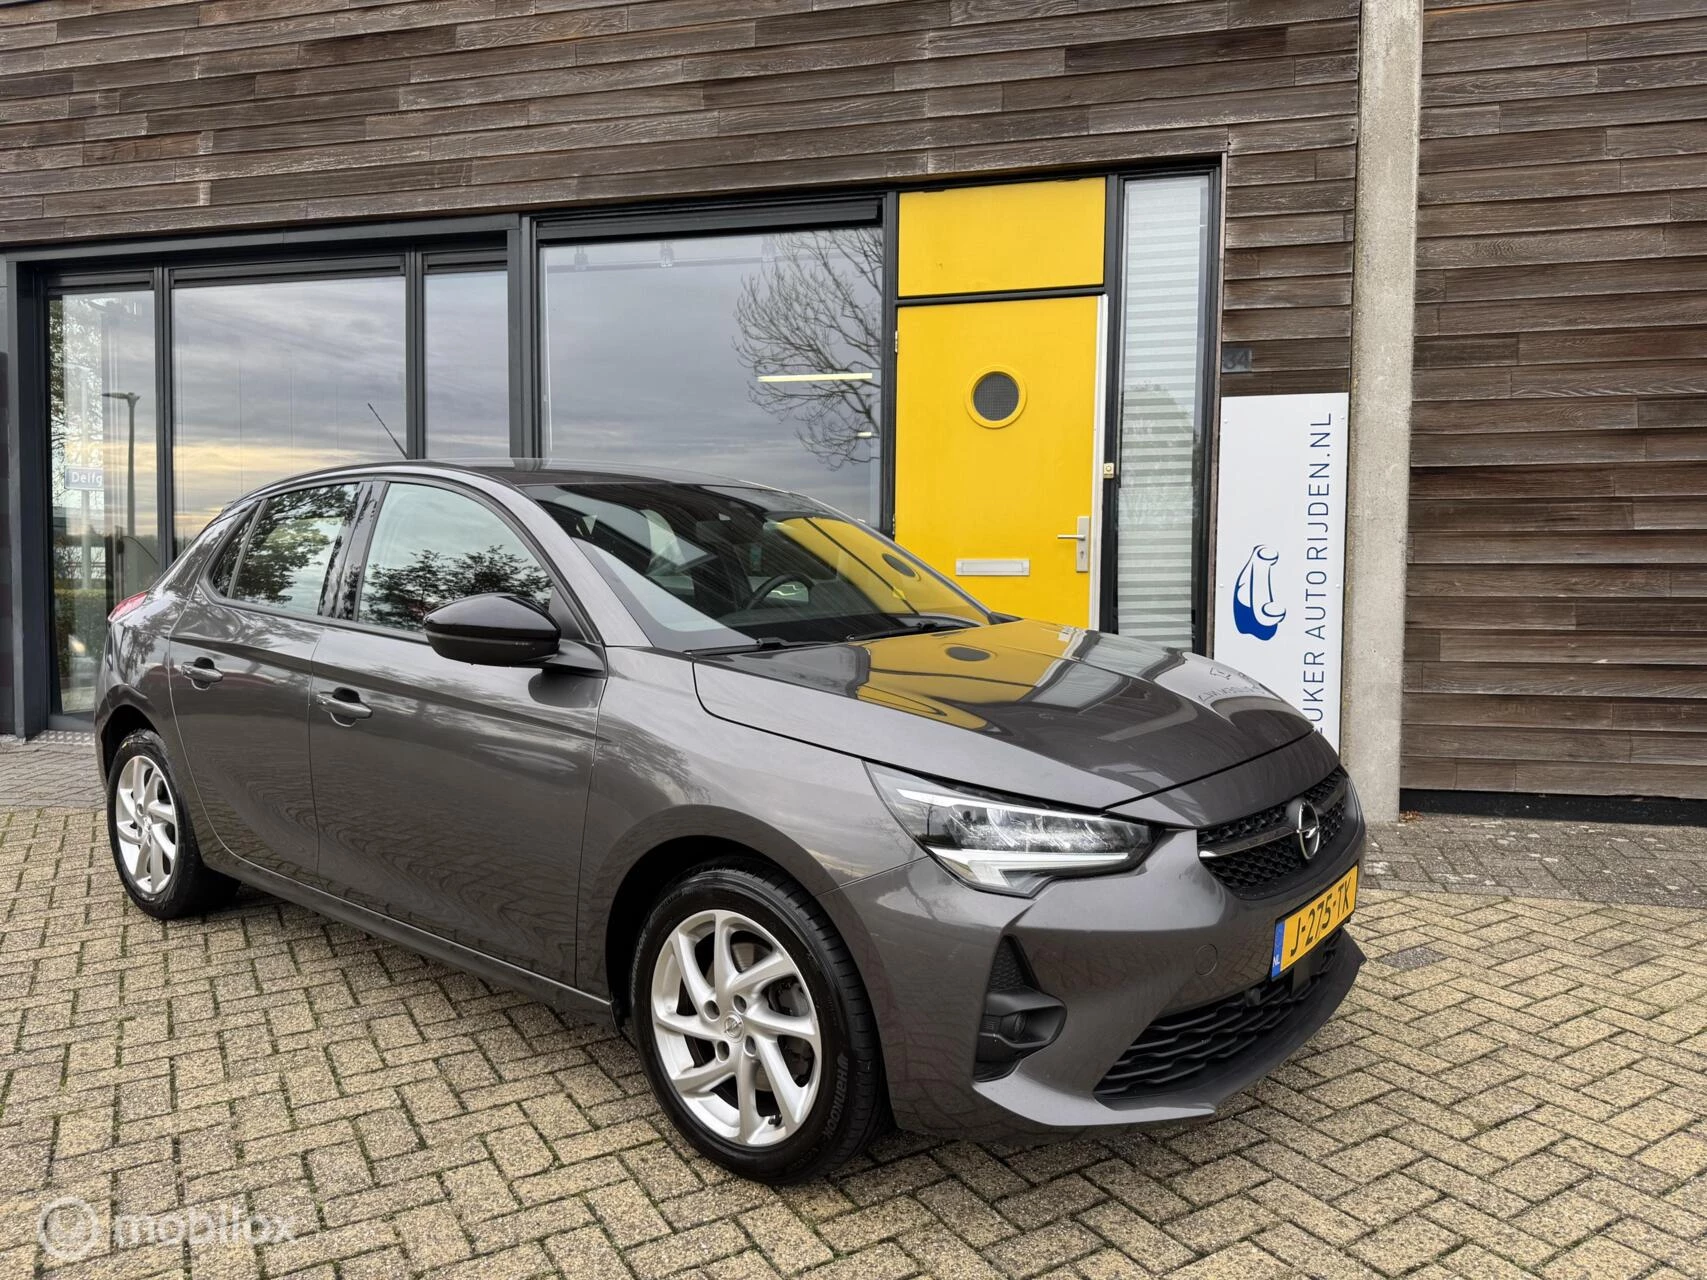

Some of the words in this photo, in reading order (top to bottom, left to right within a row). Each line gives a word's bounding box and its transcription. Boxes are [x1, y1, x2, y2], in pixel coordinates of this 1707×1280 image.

[1306, 413, 1331, 561] RIJDEN.NL
[1304, 570, 1327, 640] AUTO
[1302, 651, 1325, 734] UKER
[1272, 954, 1281, 968] NL
[1290, 876, 1351, 956] J-275-TK
